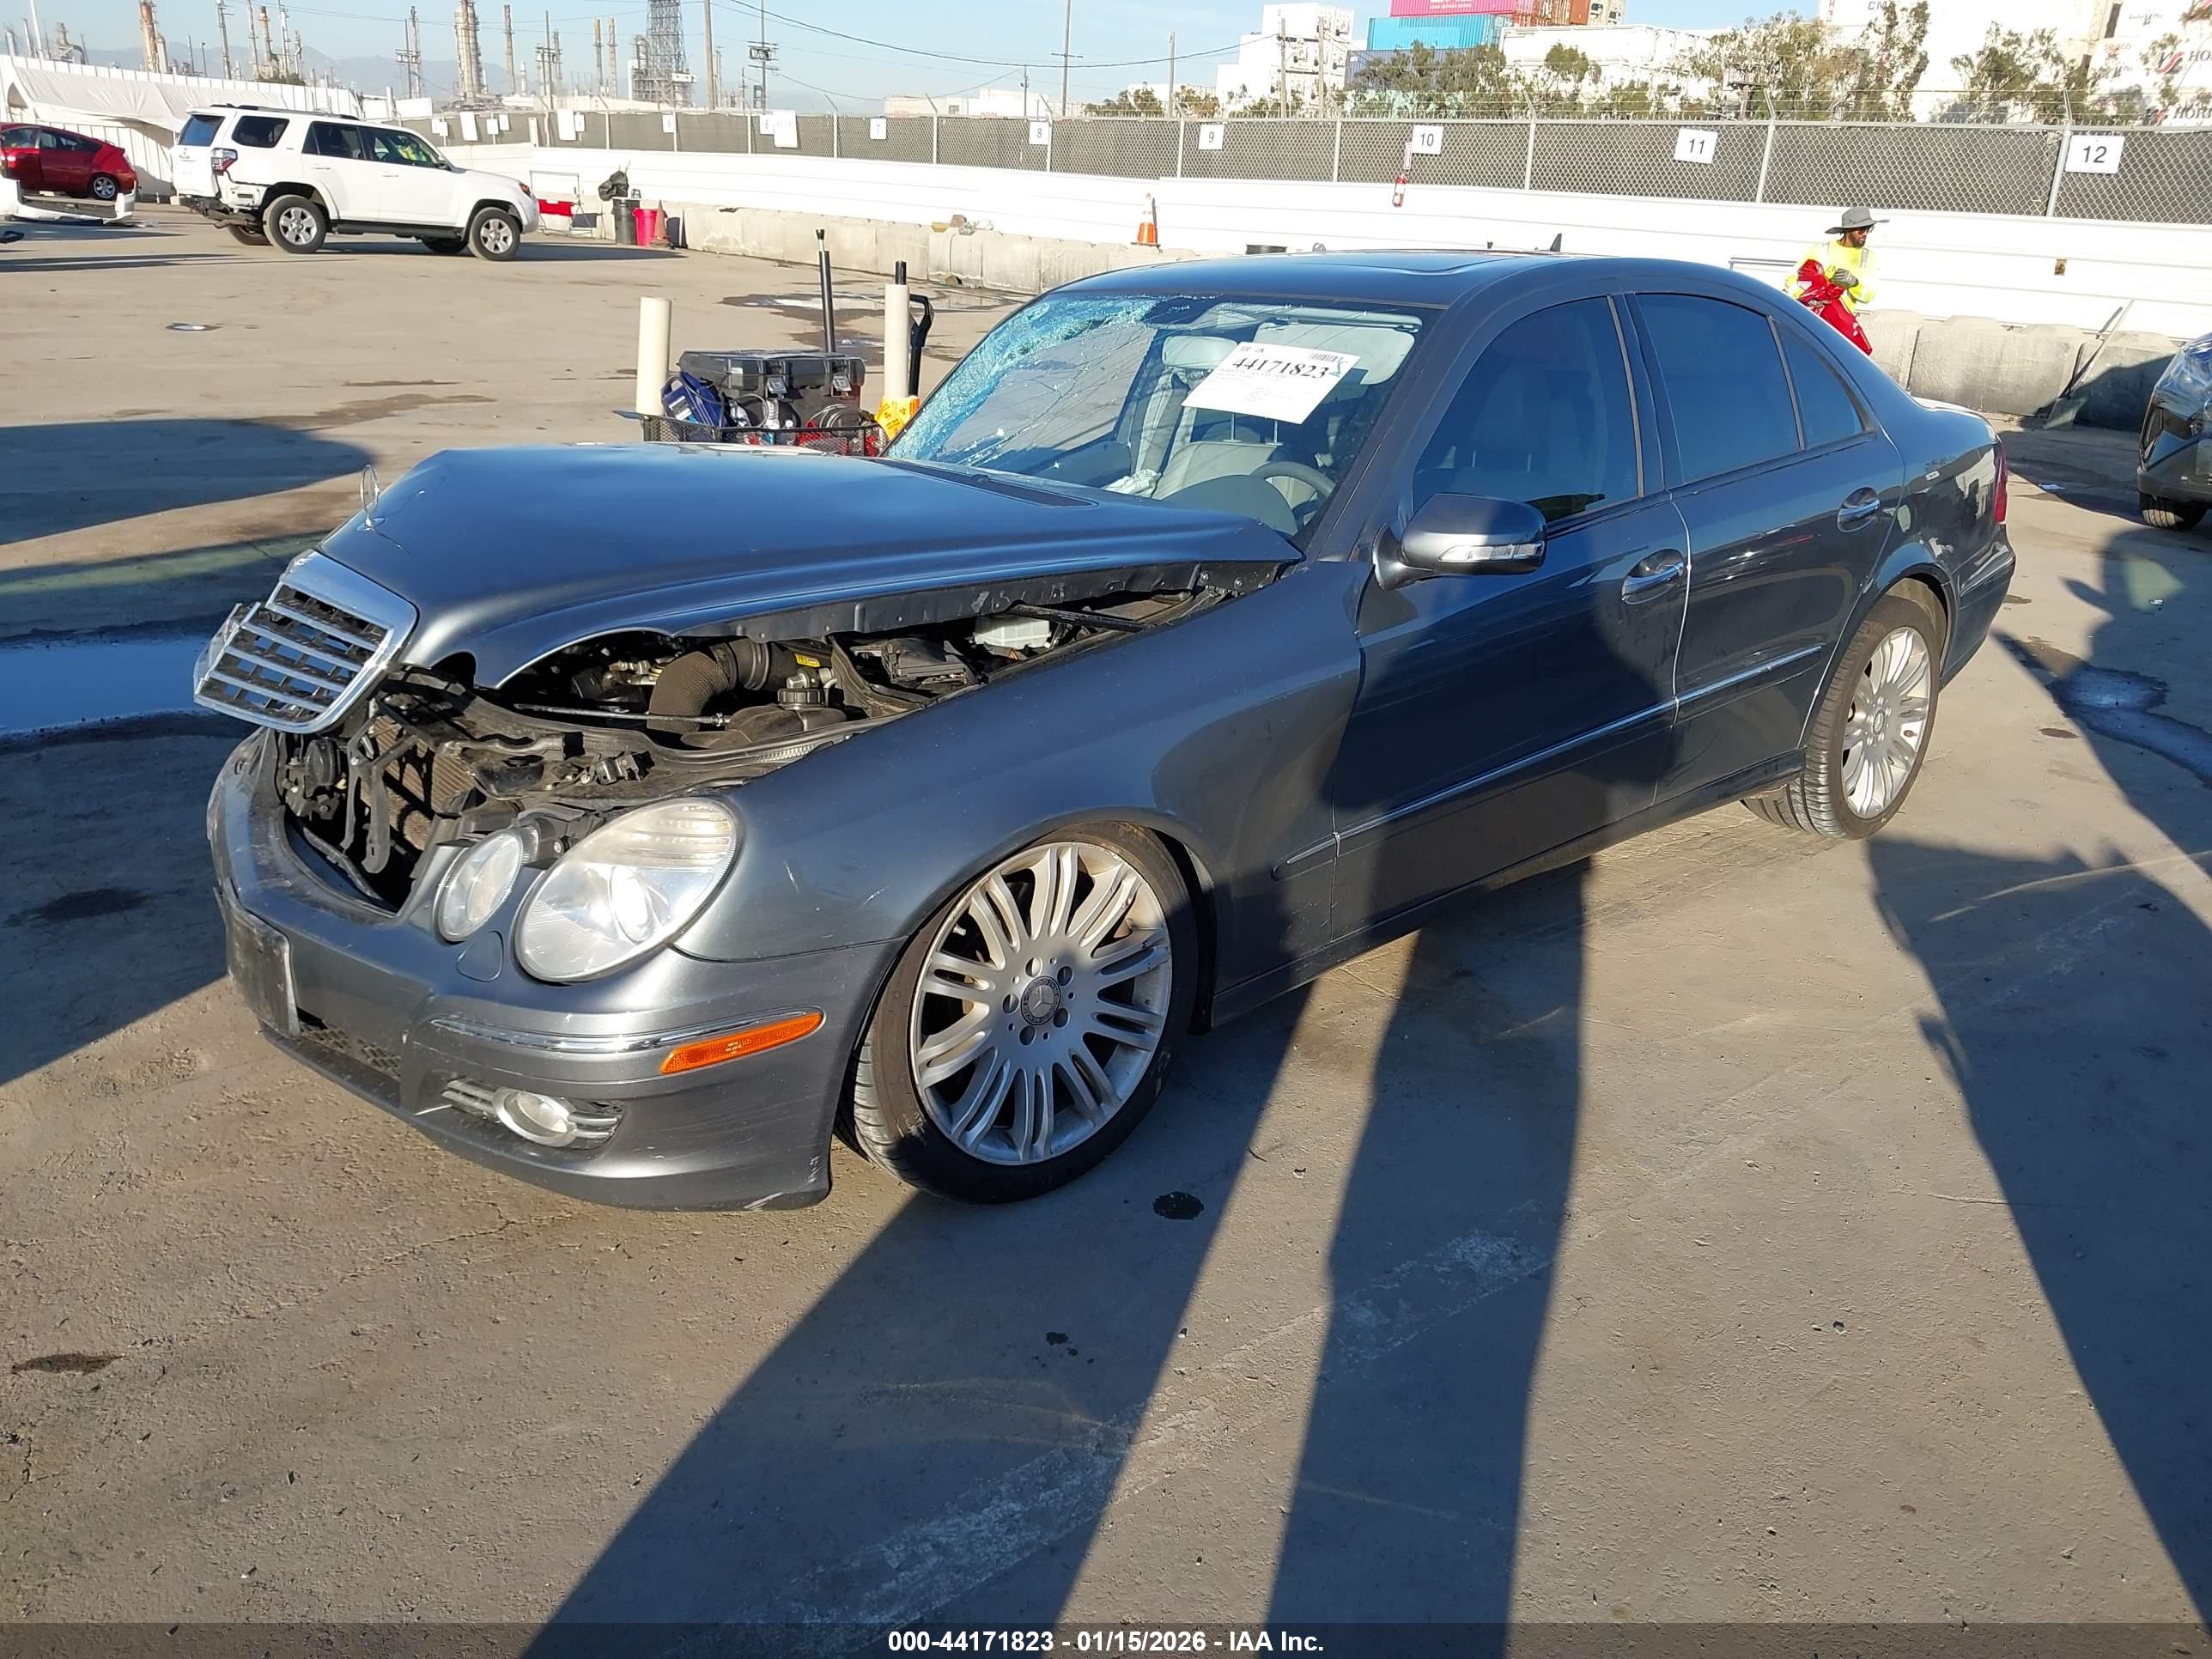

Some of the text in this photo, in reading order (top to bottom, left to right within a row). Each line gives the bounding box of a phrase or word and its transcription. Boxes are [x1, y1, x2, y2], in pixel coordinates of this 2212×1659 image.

[1036, 128, 1042, 138] 8
[1208, 131, 1215, 143] 9
[1420, 132, 1434, 147] 10
[1688, 137, 1705, 155] 11
[2083, 145, 2106, 163] 12
[1232, 357, 1329, 380] 44171823
